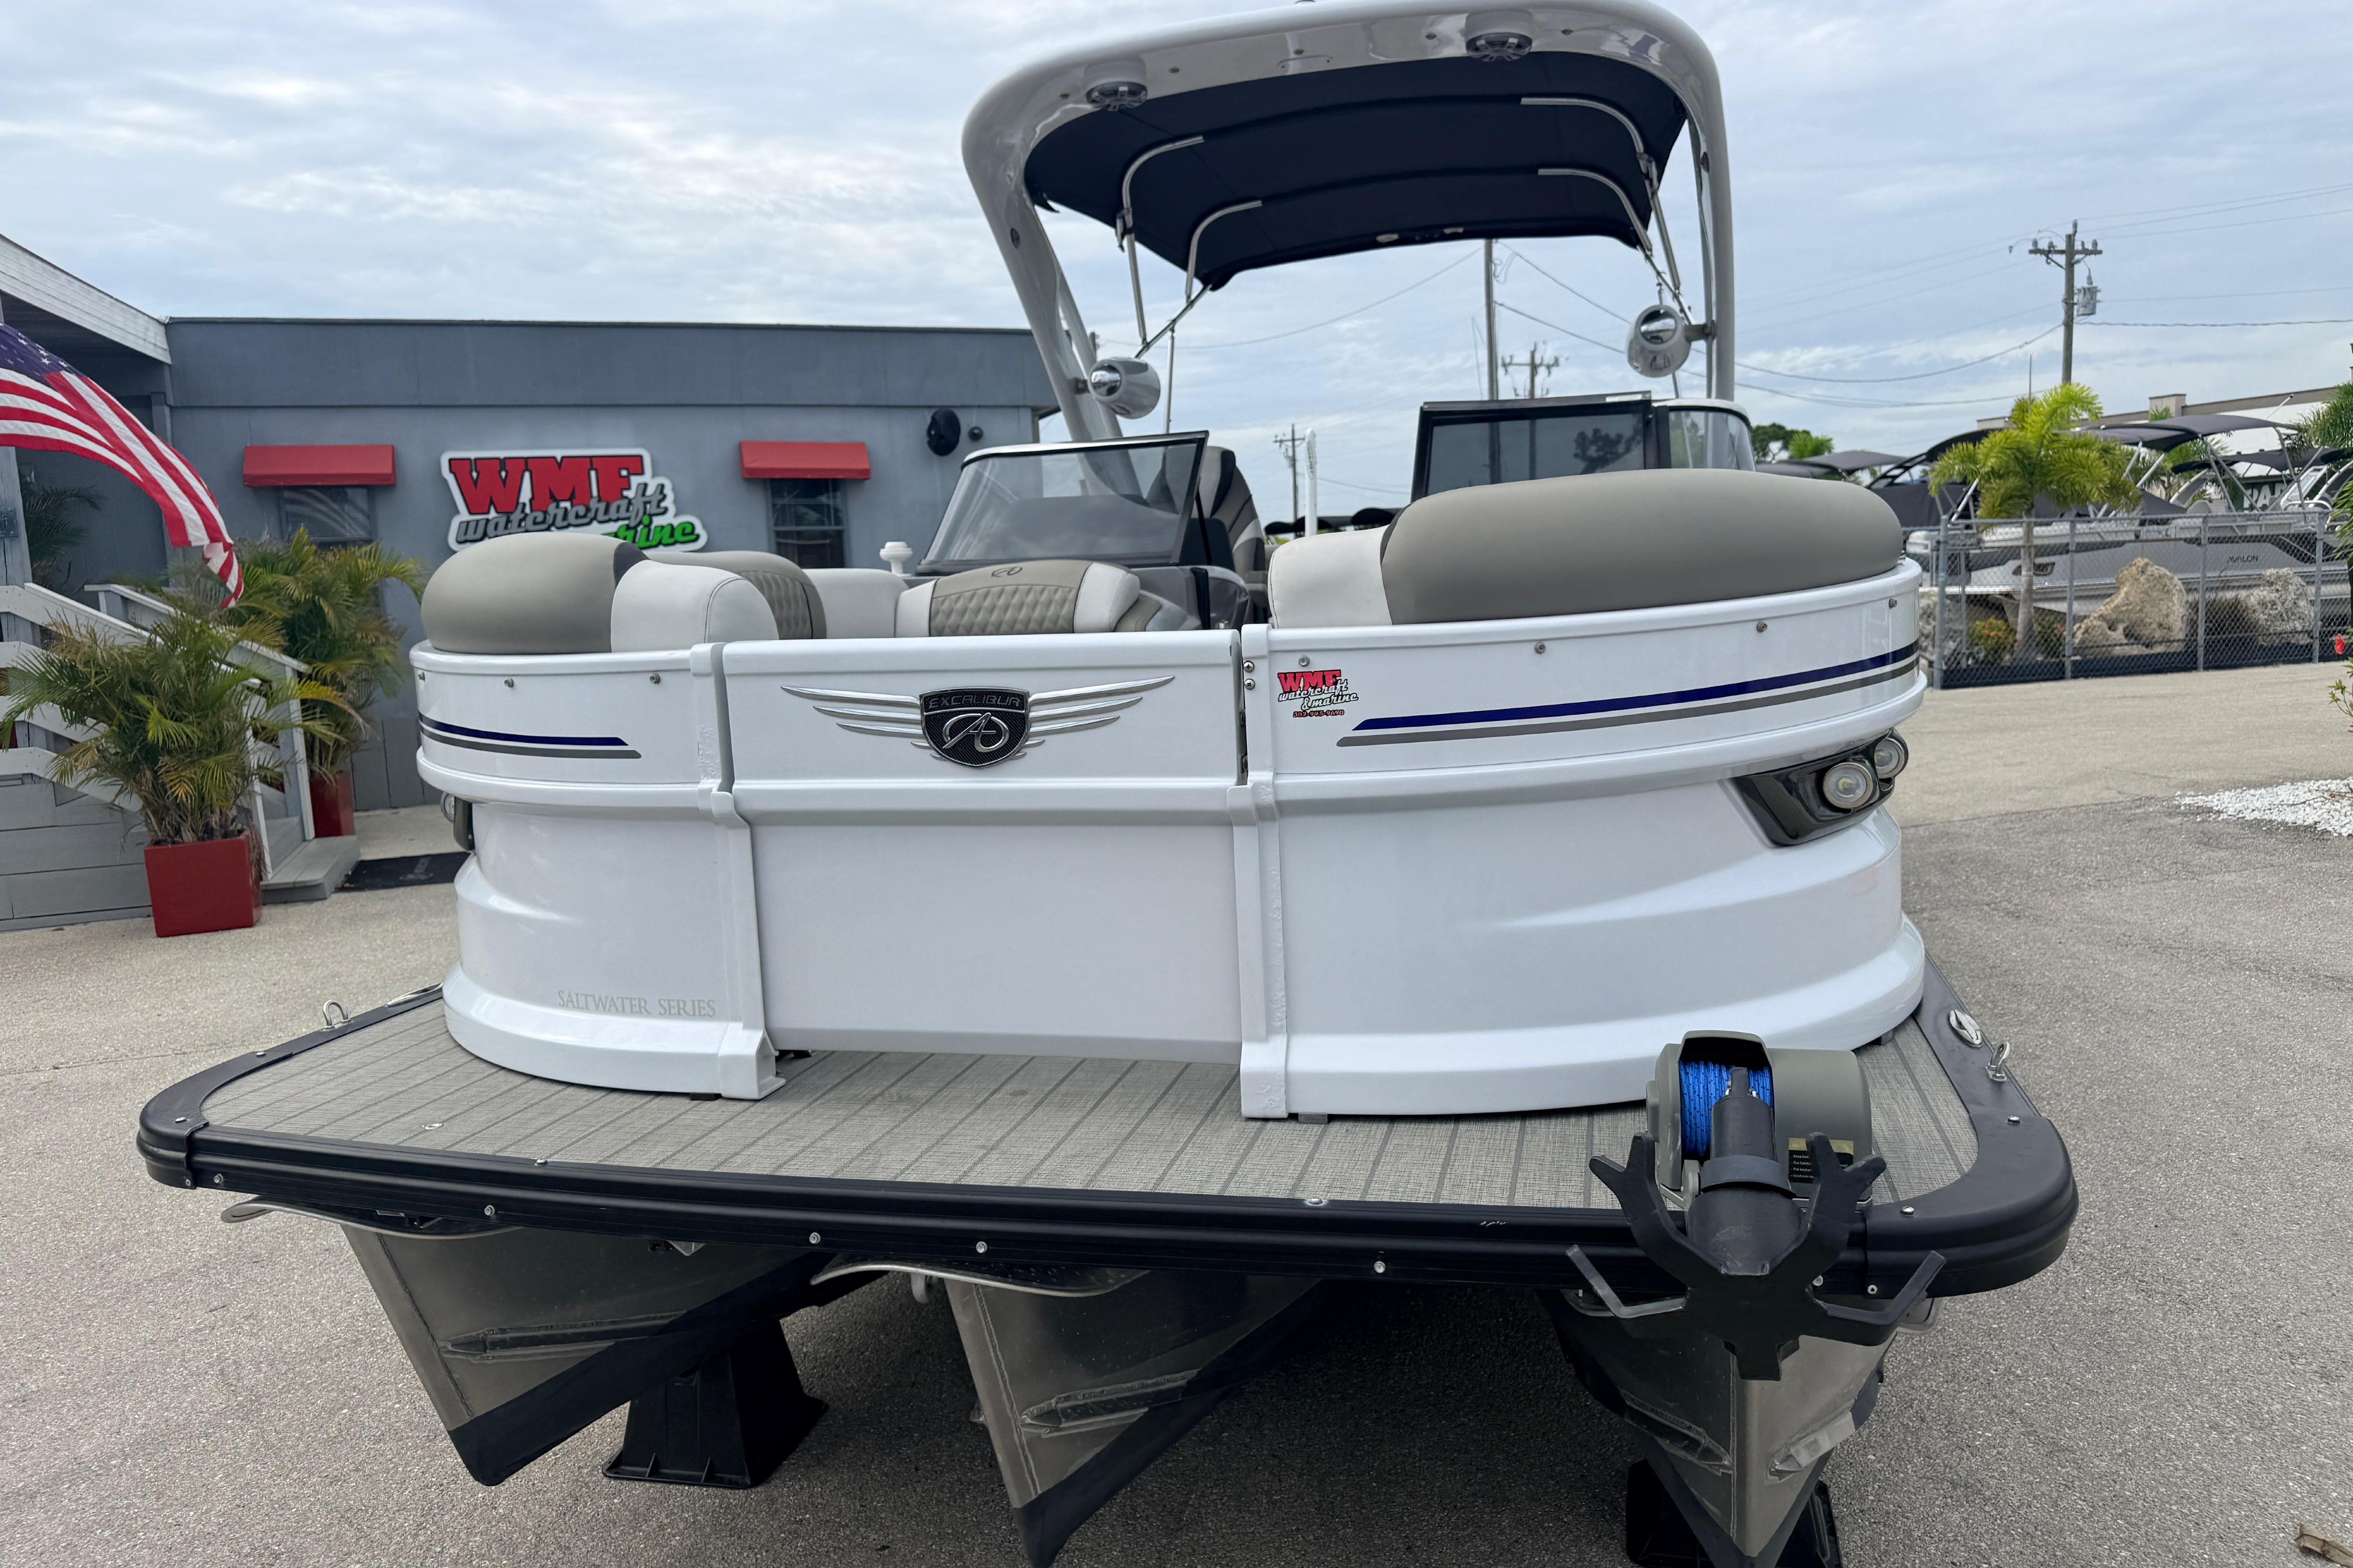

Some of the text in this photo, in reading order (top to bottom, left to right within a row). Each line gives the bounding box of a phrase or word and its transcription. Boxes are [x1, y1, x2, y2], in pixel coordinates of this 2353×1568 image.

[449, 455, 643, 514] WMF
[456, 483, 669, 543] watercraft
[2227, 555, 2258, 563] AVALON
[1277, 670, 1341, 692] WMF
[1278, 679, 1348, 701] watercraft
[928, 695, 1021, 709] EXCALIBUR
[558, 990, 716, 1017] SALTWATER SERIES
